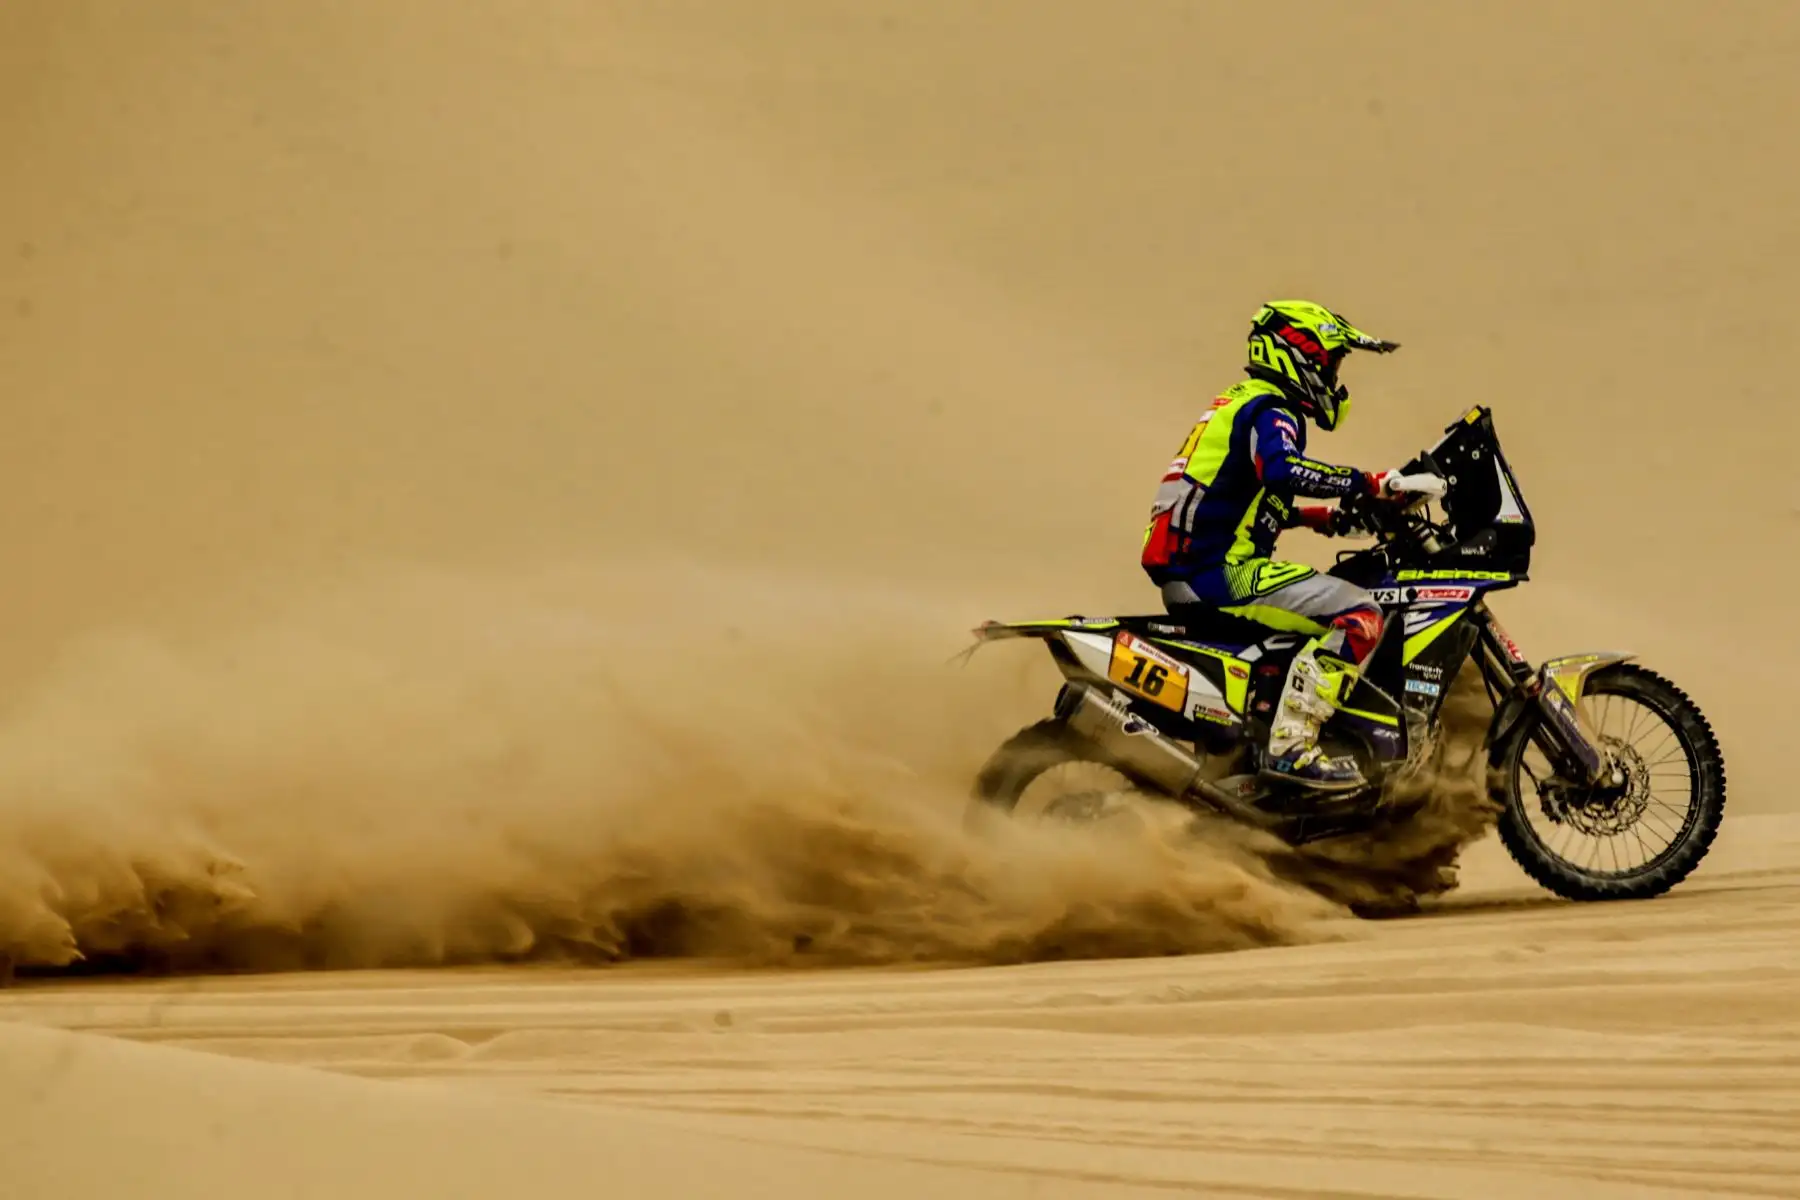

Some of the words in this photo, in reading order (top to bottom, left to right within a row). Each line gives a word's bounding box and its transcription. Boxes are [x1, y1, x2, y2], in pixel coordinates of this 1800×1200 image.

[1290, 465, 1322, 482] RTR
[1396, 569, 1511, 581] SHERCO
[1369, 591, 1396, 601] VS
[1124, 656, 1169, 697] 16
